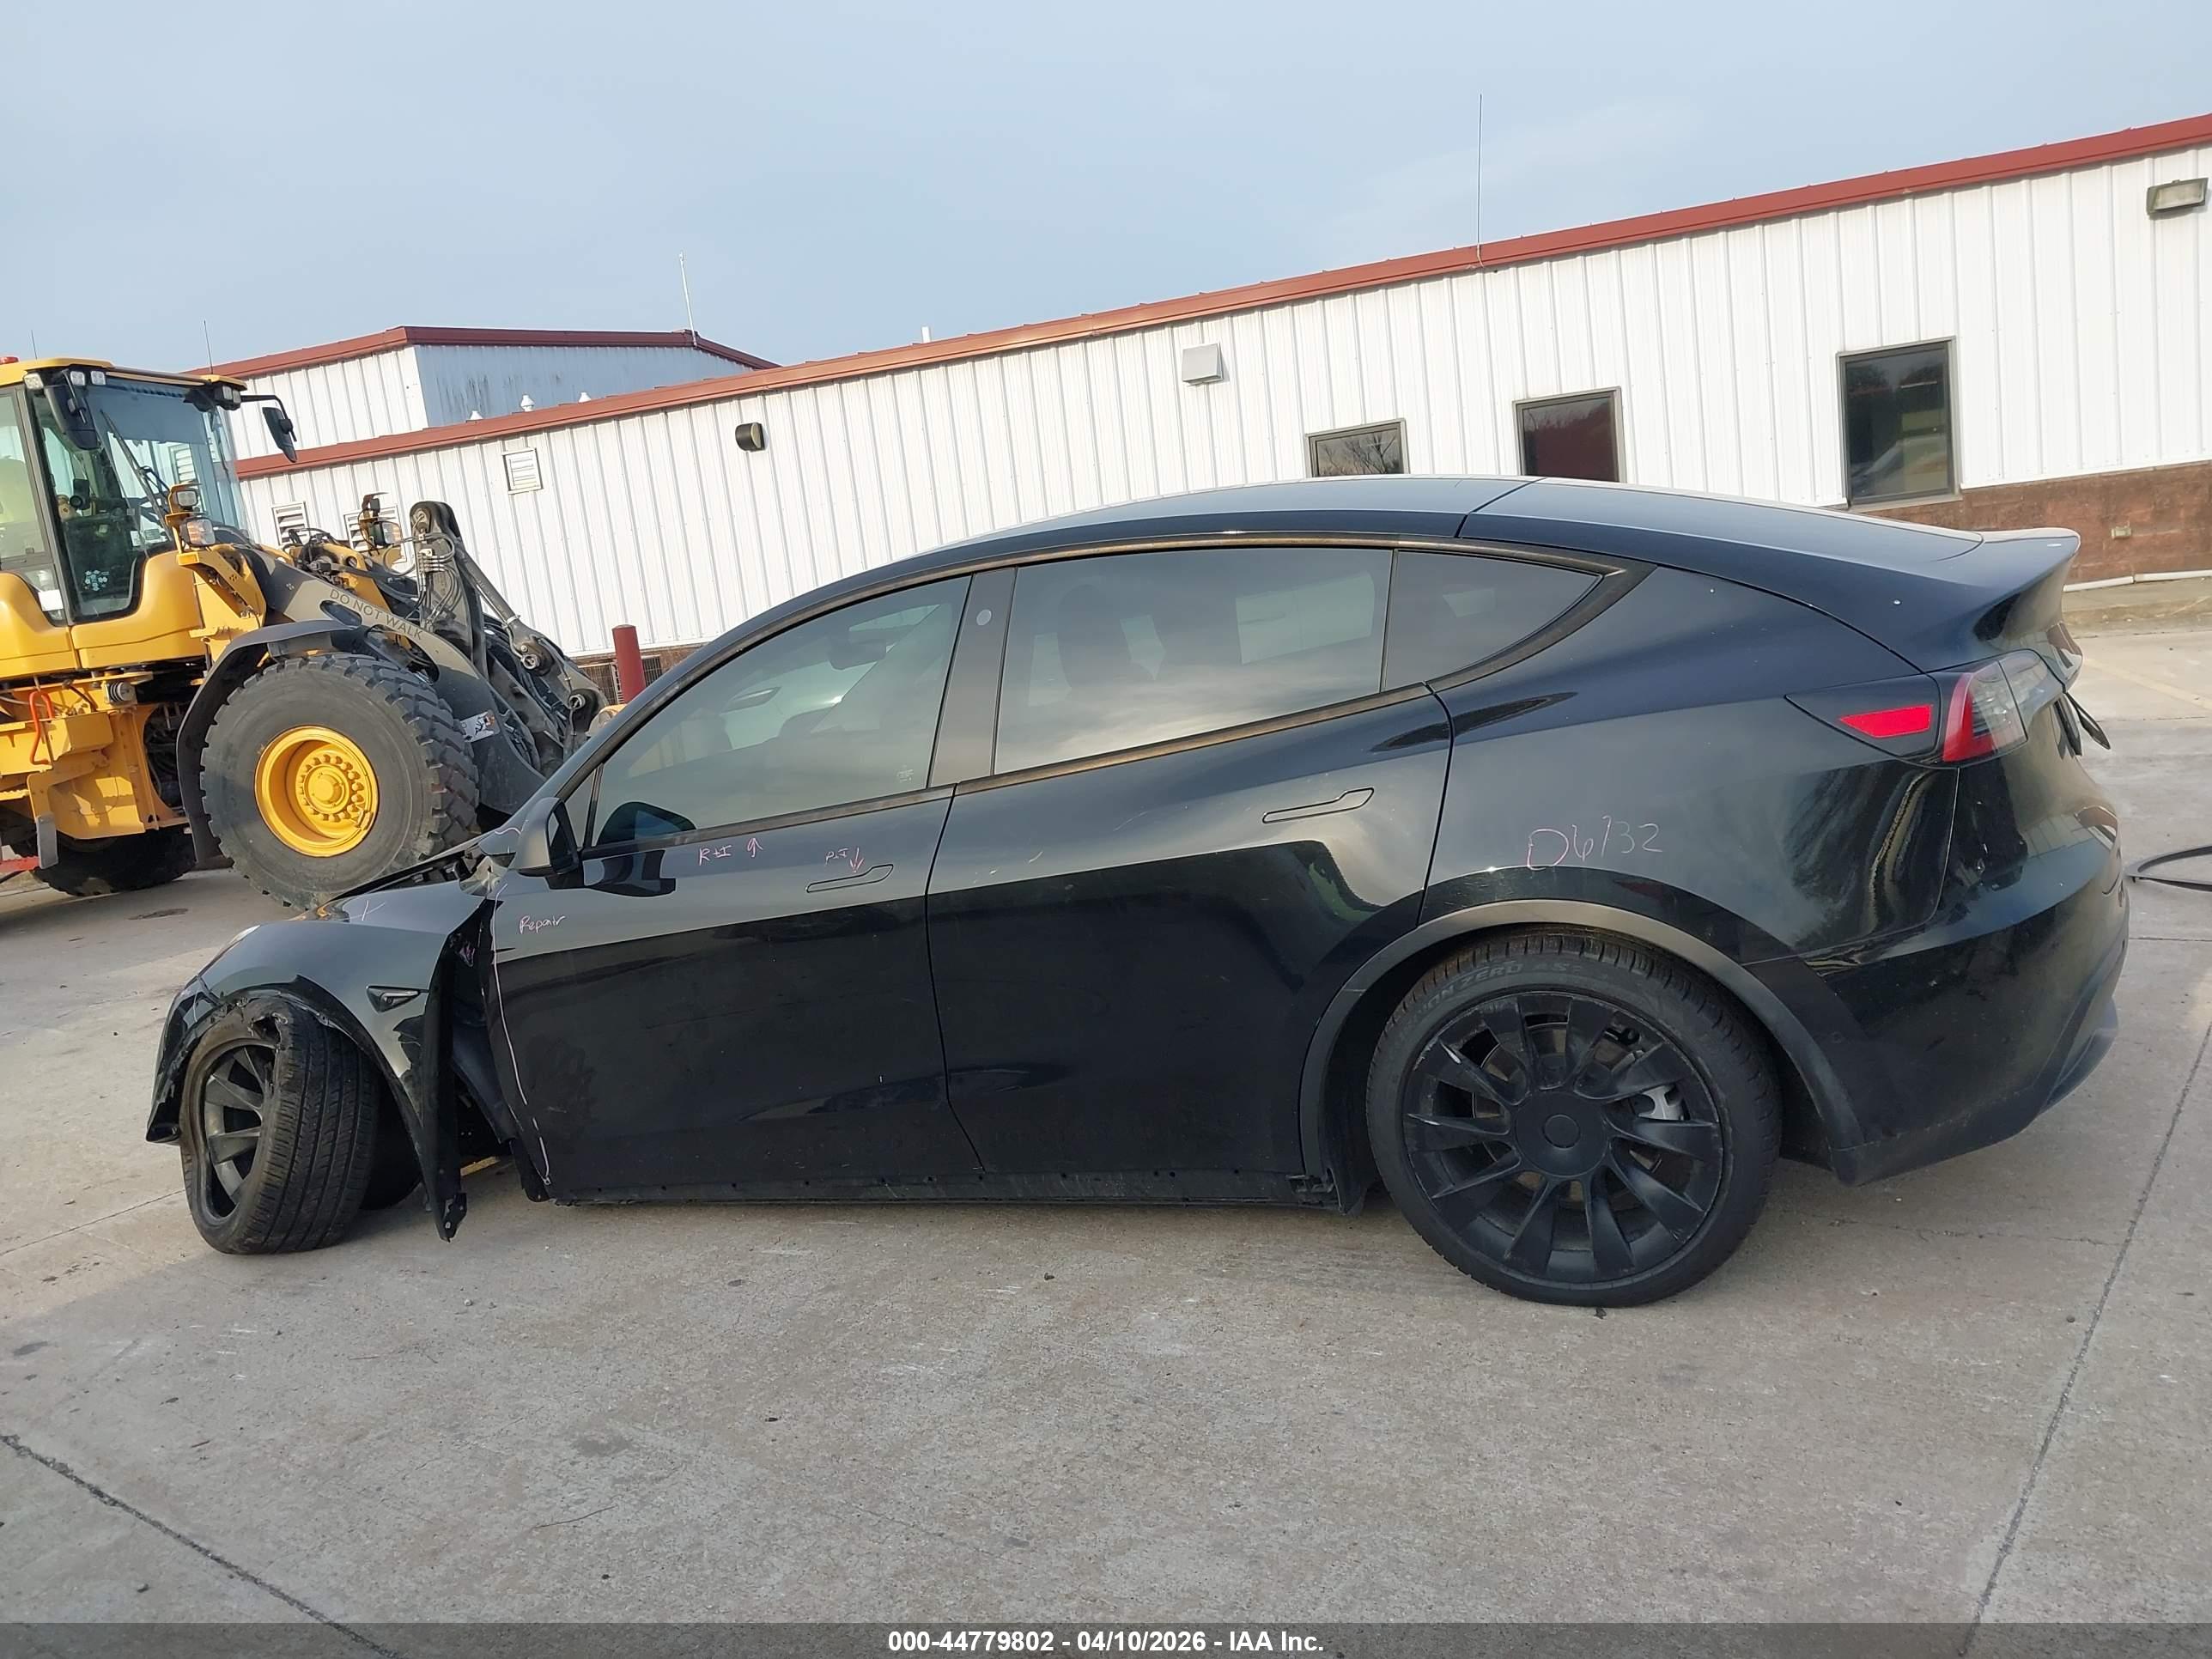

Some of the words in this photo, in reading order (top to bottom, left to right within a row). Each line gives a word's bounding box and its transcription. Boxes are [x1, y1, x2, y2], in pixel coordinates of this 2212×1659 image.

[330, 589, 350, 605] DO
[353, 600, 383, 620] NOT
[386, 615, 423, 640] WALK
[519, 915, 567, 935] Repair
